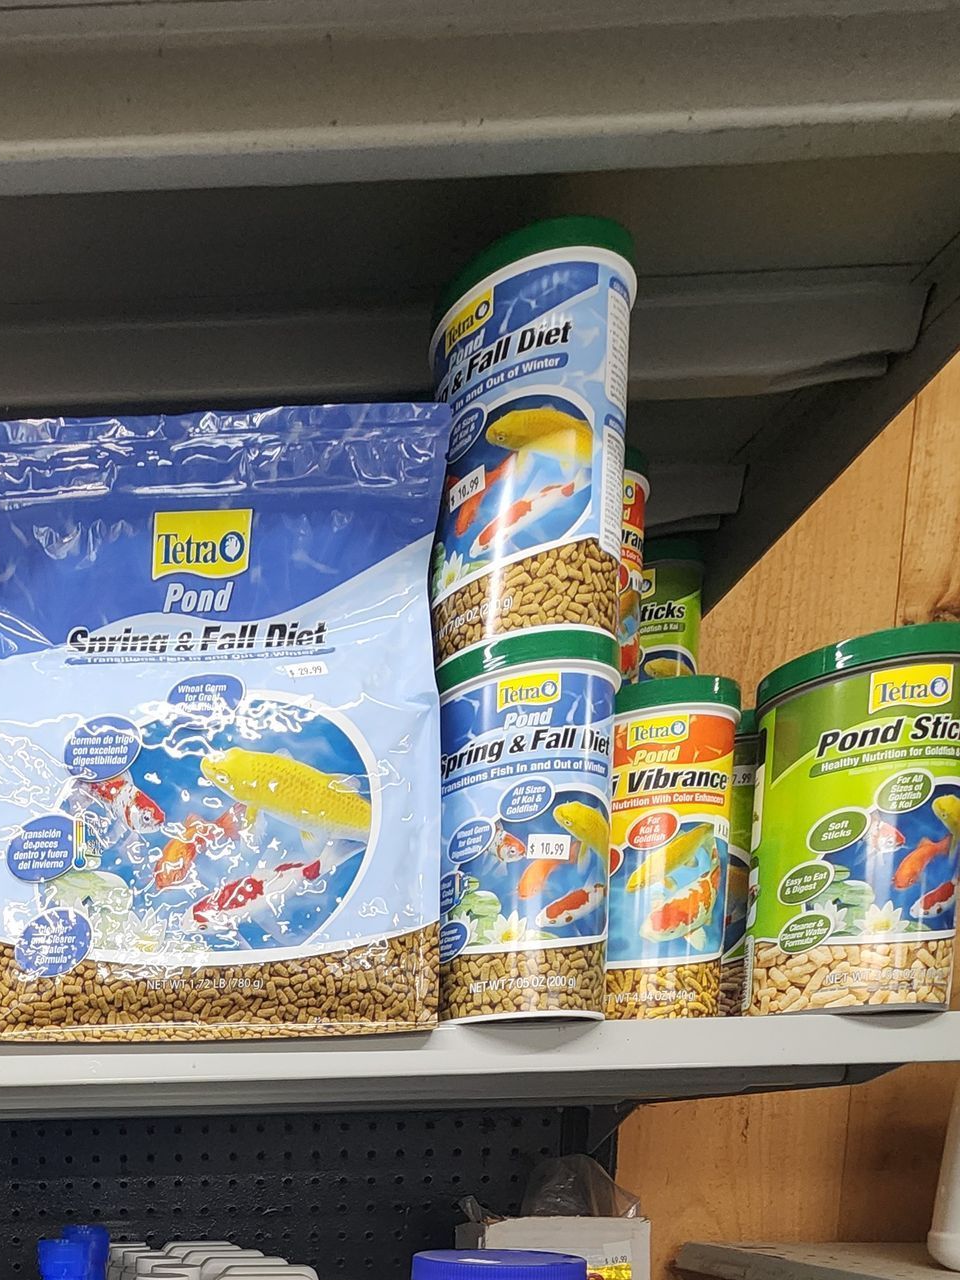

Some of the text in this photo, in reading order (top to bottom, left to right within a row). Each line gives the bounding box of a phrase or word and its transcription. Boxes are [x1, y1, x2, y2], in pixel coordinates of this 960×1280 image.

[449, 328, 486, 368] Pond
[465, 336, 512, 383] Fall
[517, 320, 571, 354] Diet
[458, 476, 480, 498] 10.99
[163, 582, 233, 613] Pond
[68, 622, 328, 655] Spring & Fall Diet
[297, 665, 322, 676] 29.99
[504, 708, 552, 730] Pond
[509, 735, 526, 754] &
[531, 728, 577, 750] Fall
[582, 728, 610, 755] Diet
[816, 717, 905, 759] Pond
[633, 746, 681, 766] Pond
[821, 748, 907, 772] Healthy Nutrition
[441, 760, 606, 793] Transitions Fish In and Out of Winter
[628, 766, 727, 793] Vibrance
[822, 829, 852, 840] Sticks
[828, 820, 849, 830] Soft
[541, 843, 565, 855] 10.99
[611, 1256, 627, 1264] 49.99
